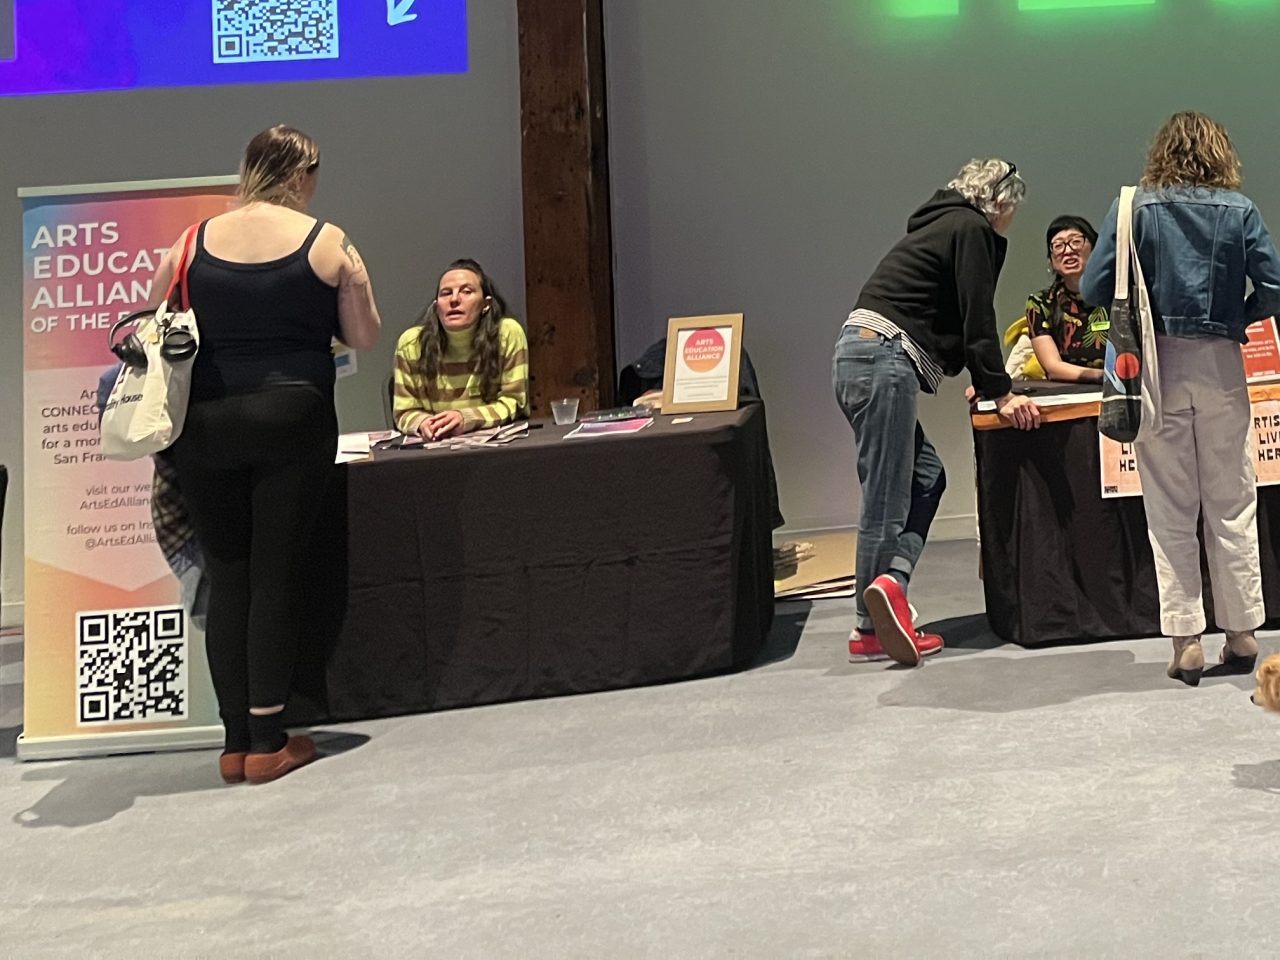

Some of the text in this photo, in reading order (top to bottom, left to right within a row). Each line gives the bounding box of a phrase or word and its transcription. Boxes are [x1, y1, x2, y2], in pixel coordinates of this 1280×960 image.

[31, 221, 119, 249] ARTS
[31, 279, 152, 310] ALLIAN
[31, 315, 58, 333] OF
[66, 312, 110, 331] THE
[80, 389, 98, 400] Ar
[43, 423, 69, 434] arts
[41, 438, 59, 449] for
[63, 439, 71, 448] a
[54, 452, 106, 464] San Fra
[86, 484, 107, 496] visit
[111, 485, 130, 494] our
[67, 524, 101, 535] follow
[104, 525, 118, 533] us
[120, 523, 135, 531] on
